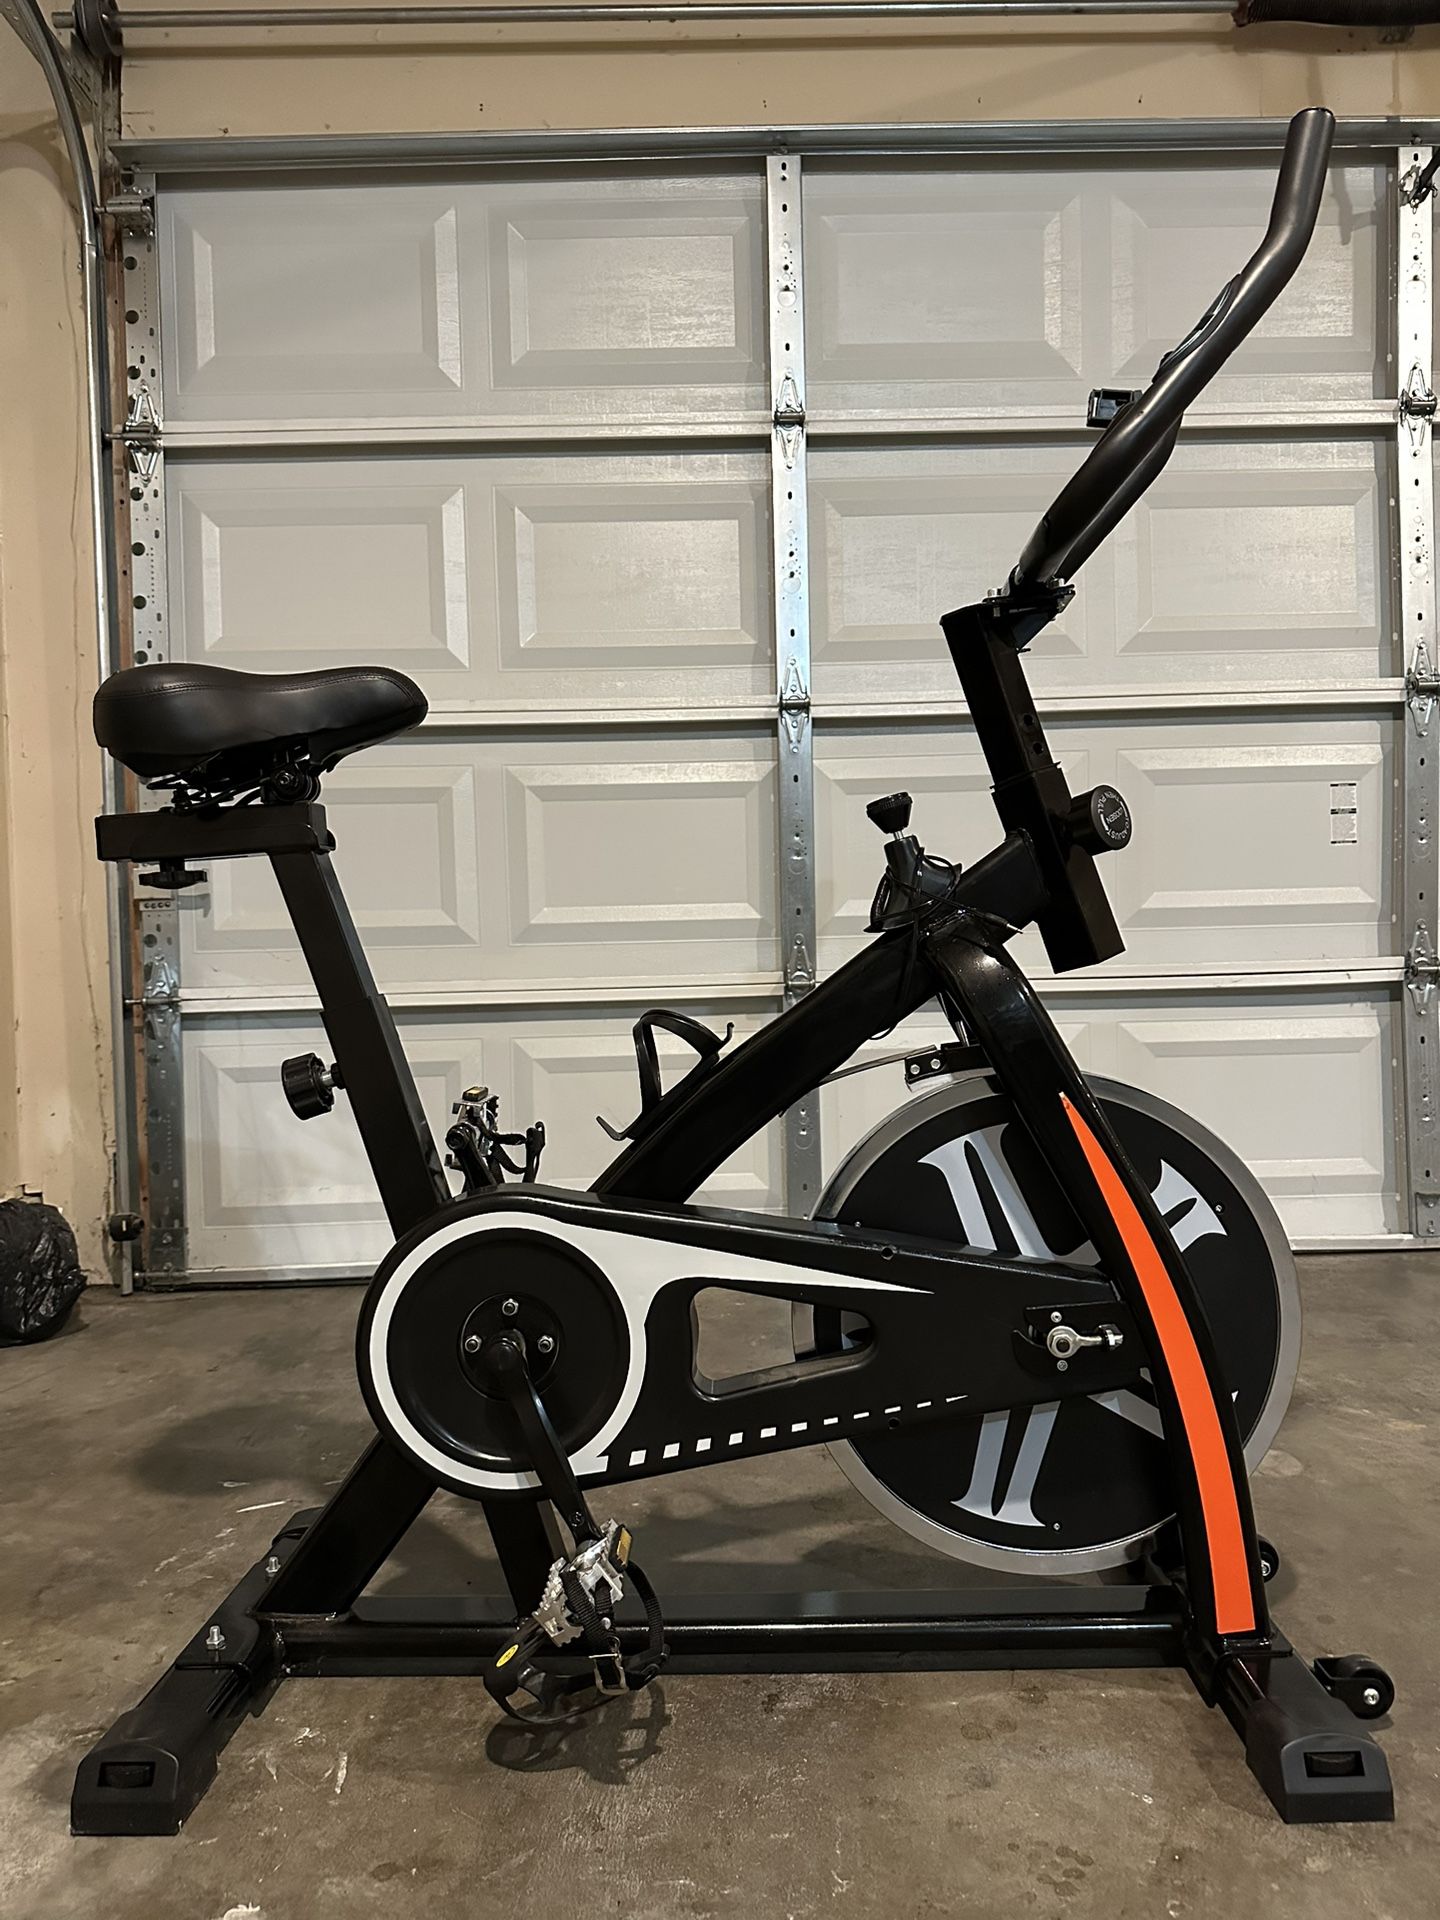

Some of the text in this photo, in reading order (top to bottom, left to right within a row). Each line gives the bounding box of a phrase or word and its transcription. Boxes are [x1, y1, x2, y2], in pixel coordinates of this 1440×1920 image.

[1097, 795, 1107, 814] PULL
[1106, 807, 1123, 824] LOOSEN
[1107, 817, 1130, 840] TO ADJUST
